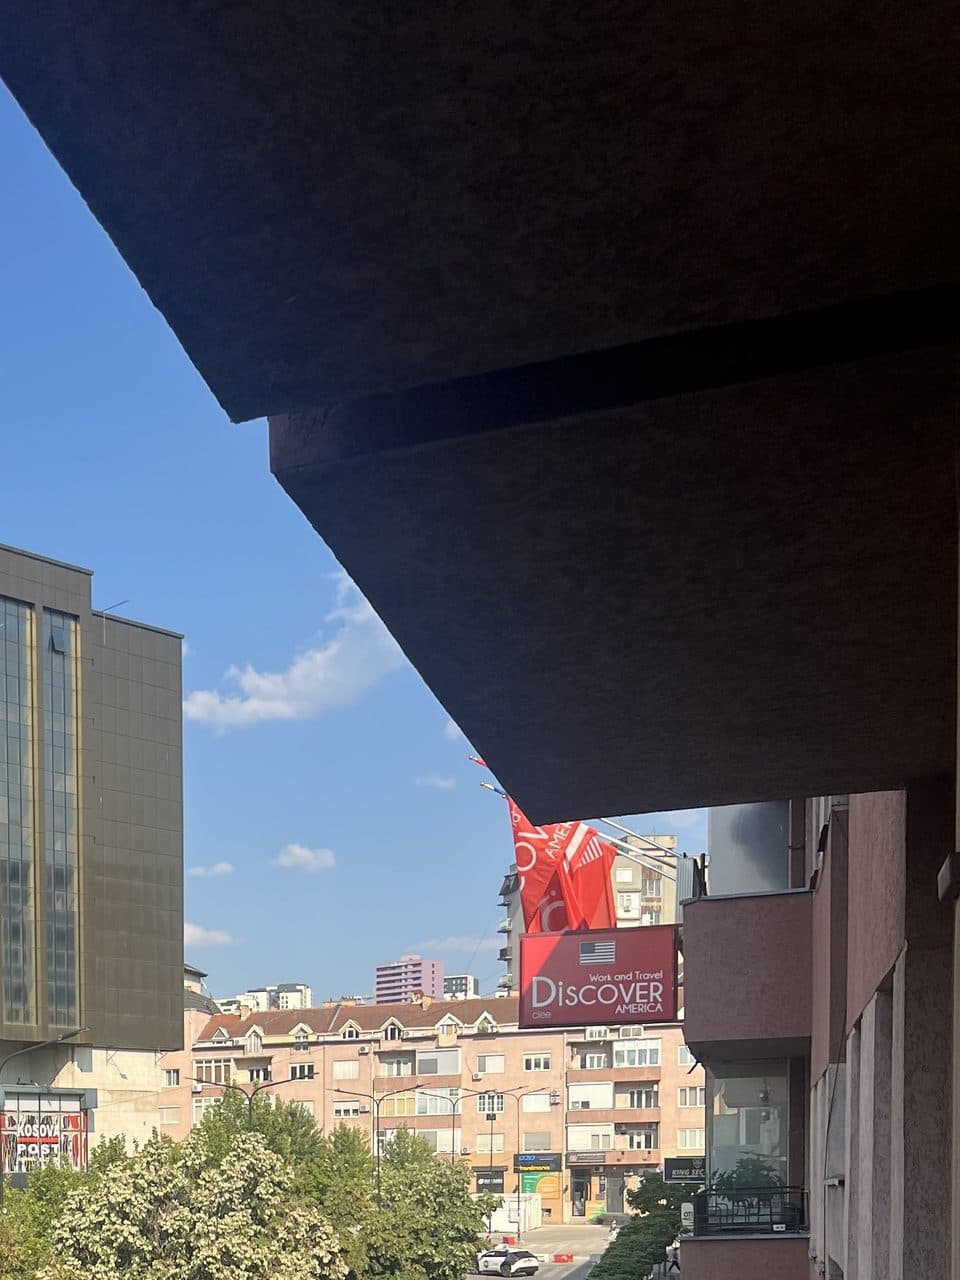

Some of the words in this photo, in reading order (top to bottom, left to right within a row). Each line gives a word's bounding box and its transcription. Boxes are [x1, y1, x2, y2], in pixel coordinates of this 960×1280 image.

[589, 973, 611, 982] Work
[615, 972, 632, 981] and
[635, 970, 663, 980] Travel
[615, 1003, 663, 1014] AMERICA
[17, 1123, 60, 1137] KOSOVA
[17, 1144, 59, 1155] POST
